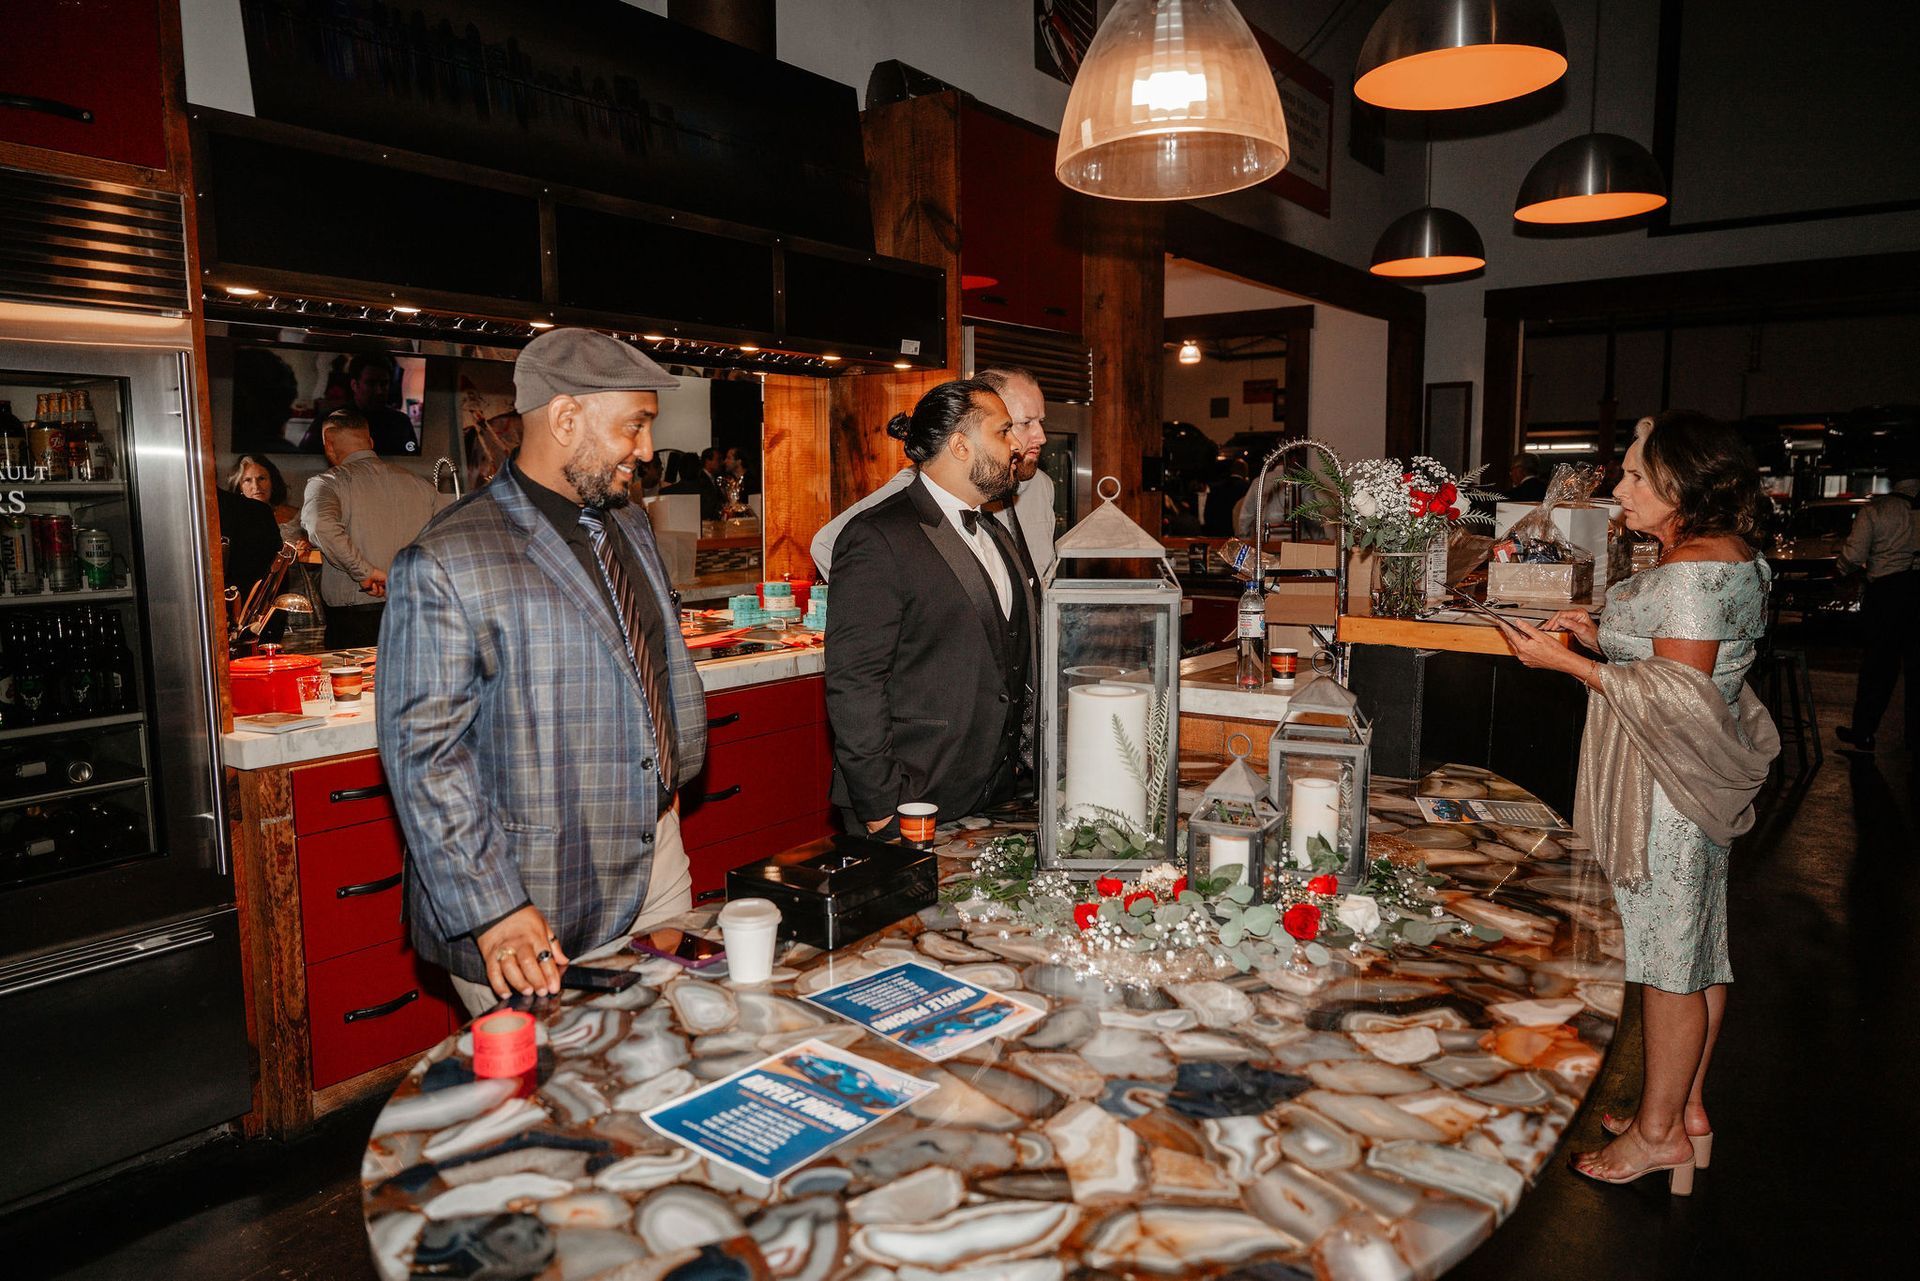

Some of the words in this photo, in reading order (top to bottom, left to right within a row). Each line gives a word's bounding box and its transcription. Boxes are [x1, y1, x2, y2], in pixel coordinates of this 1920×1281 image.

[1, 534, 16, 571] TRULY
[923, 987, 977, 1010] RAFFLE
[870, 1006, 930, 1032] PRICING
[738, 1075, 805, 1104] RAFFLE
[790, 1097, 867, 1131] PRICING
